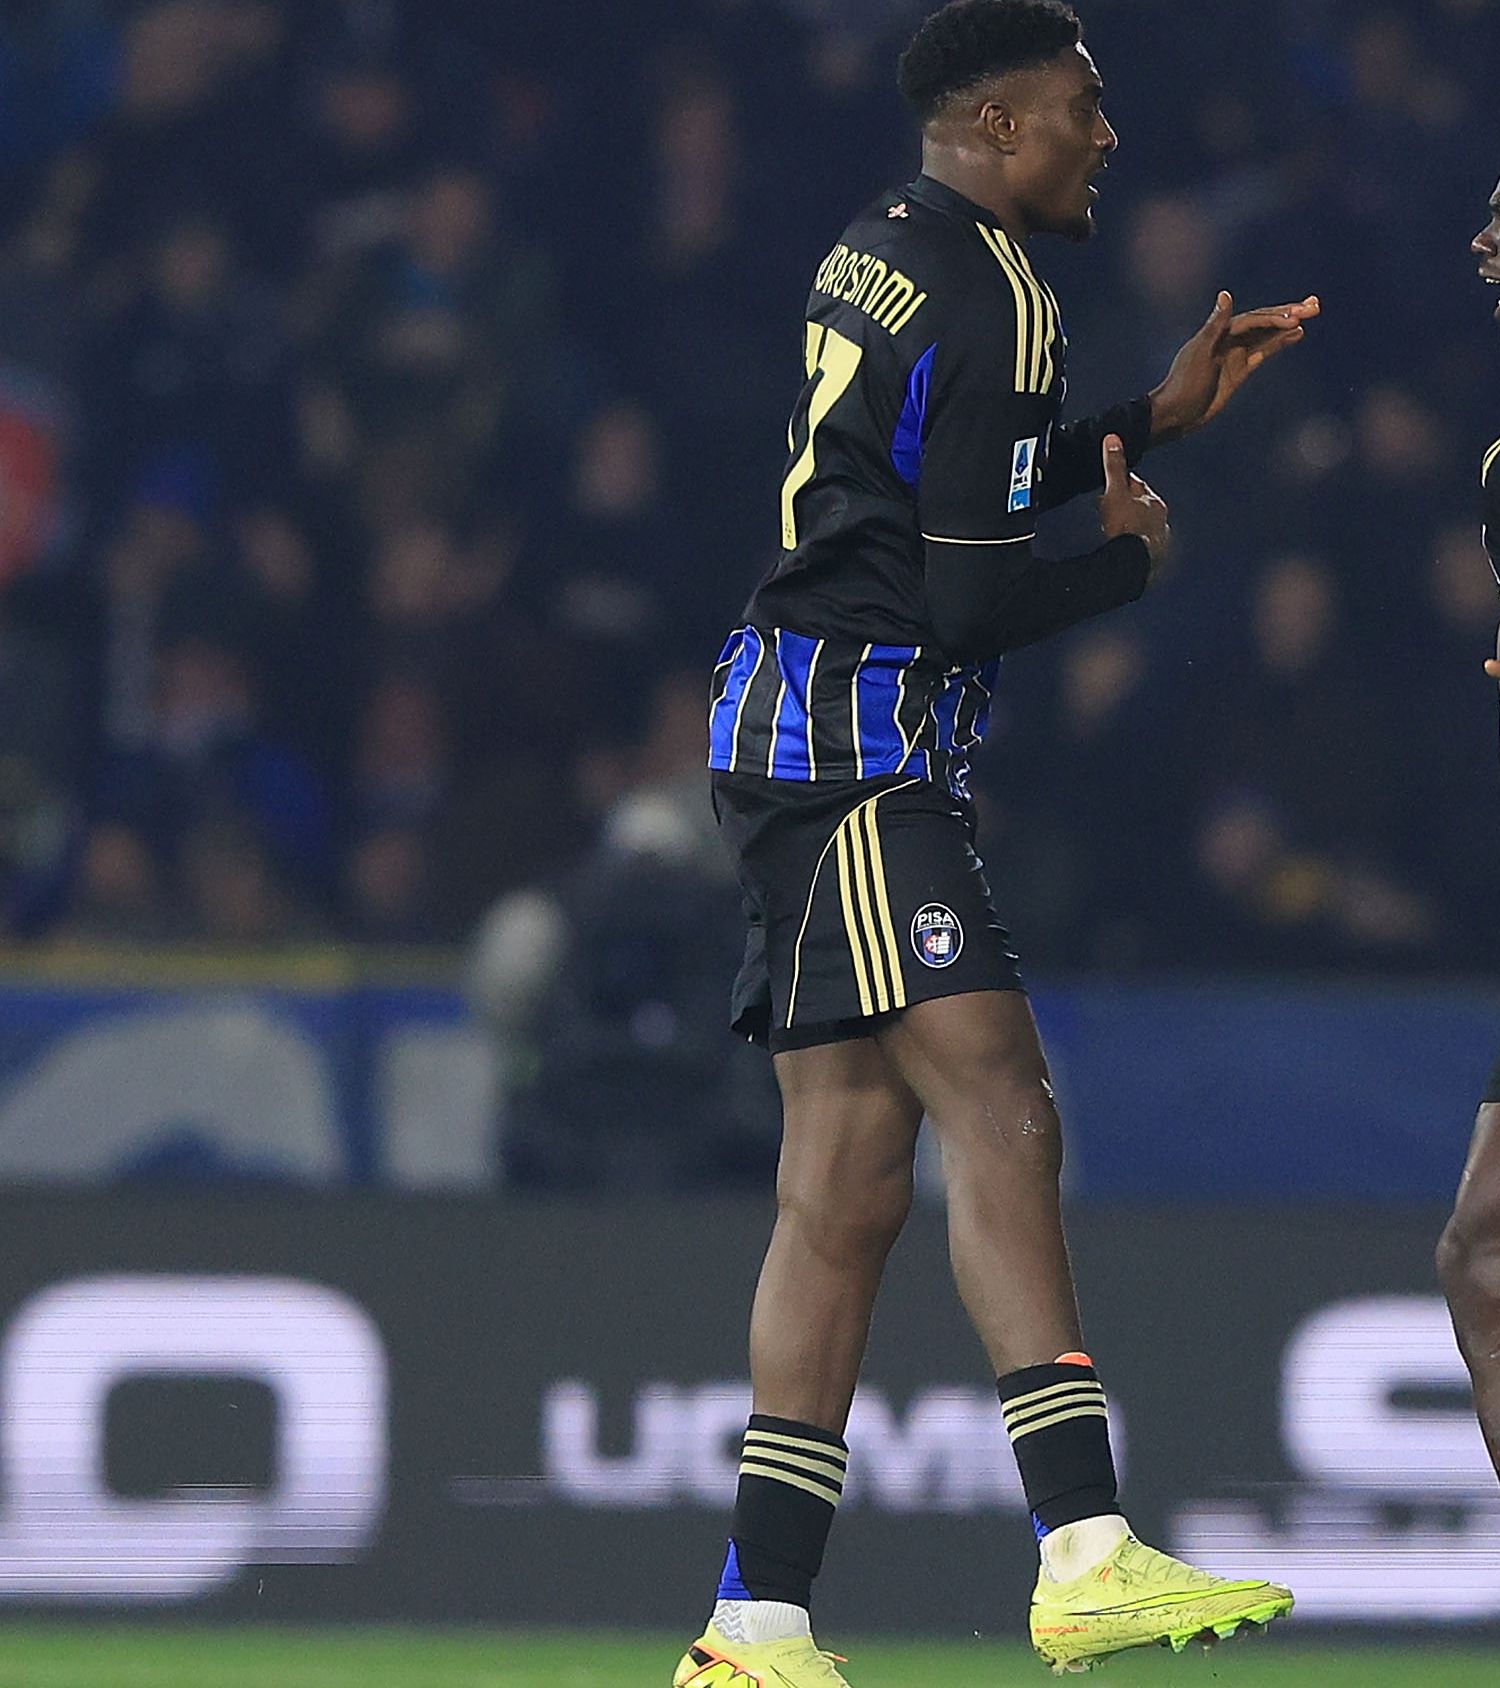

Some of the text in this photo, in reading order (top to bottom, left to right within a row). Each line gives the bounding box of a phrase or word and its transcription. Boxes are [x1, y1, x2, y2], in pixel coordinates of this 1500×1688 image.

[815, 243, 927, 335] UROSINMI
[916, 911, 955, 929] PISA
[540, 1377, 1127, 1510] UOM
